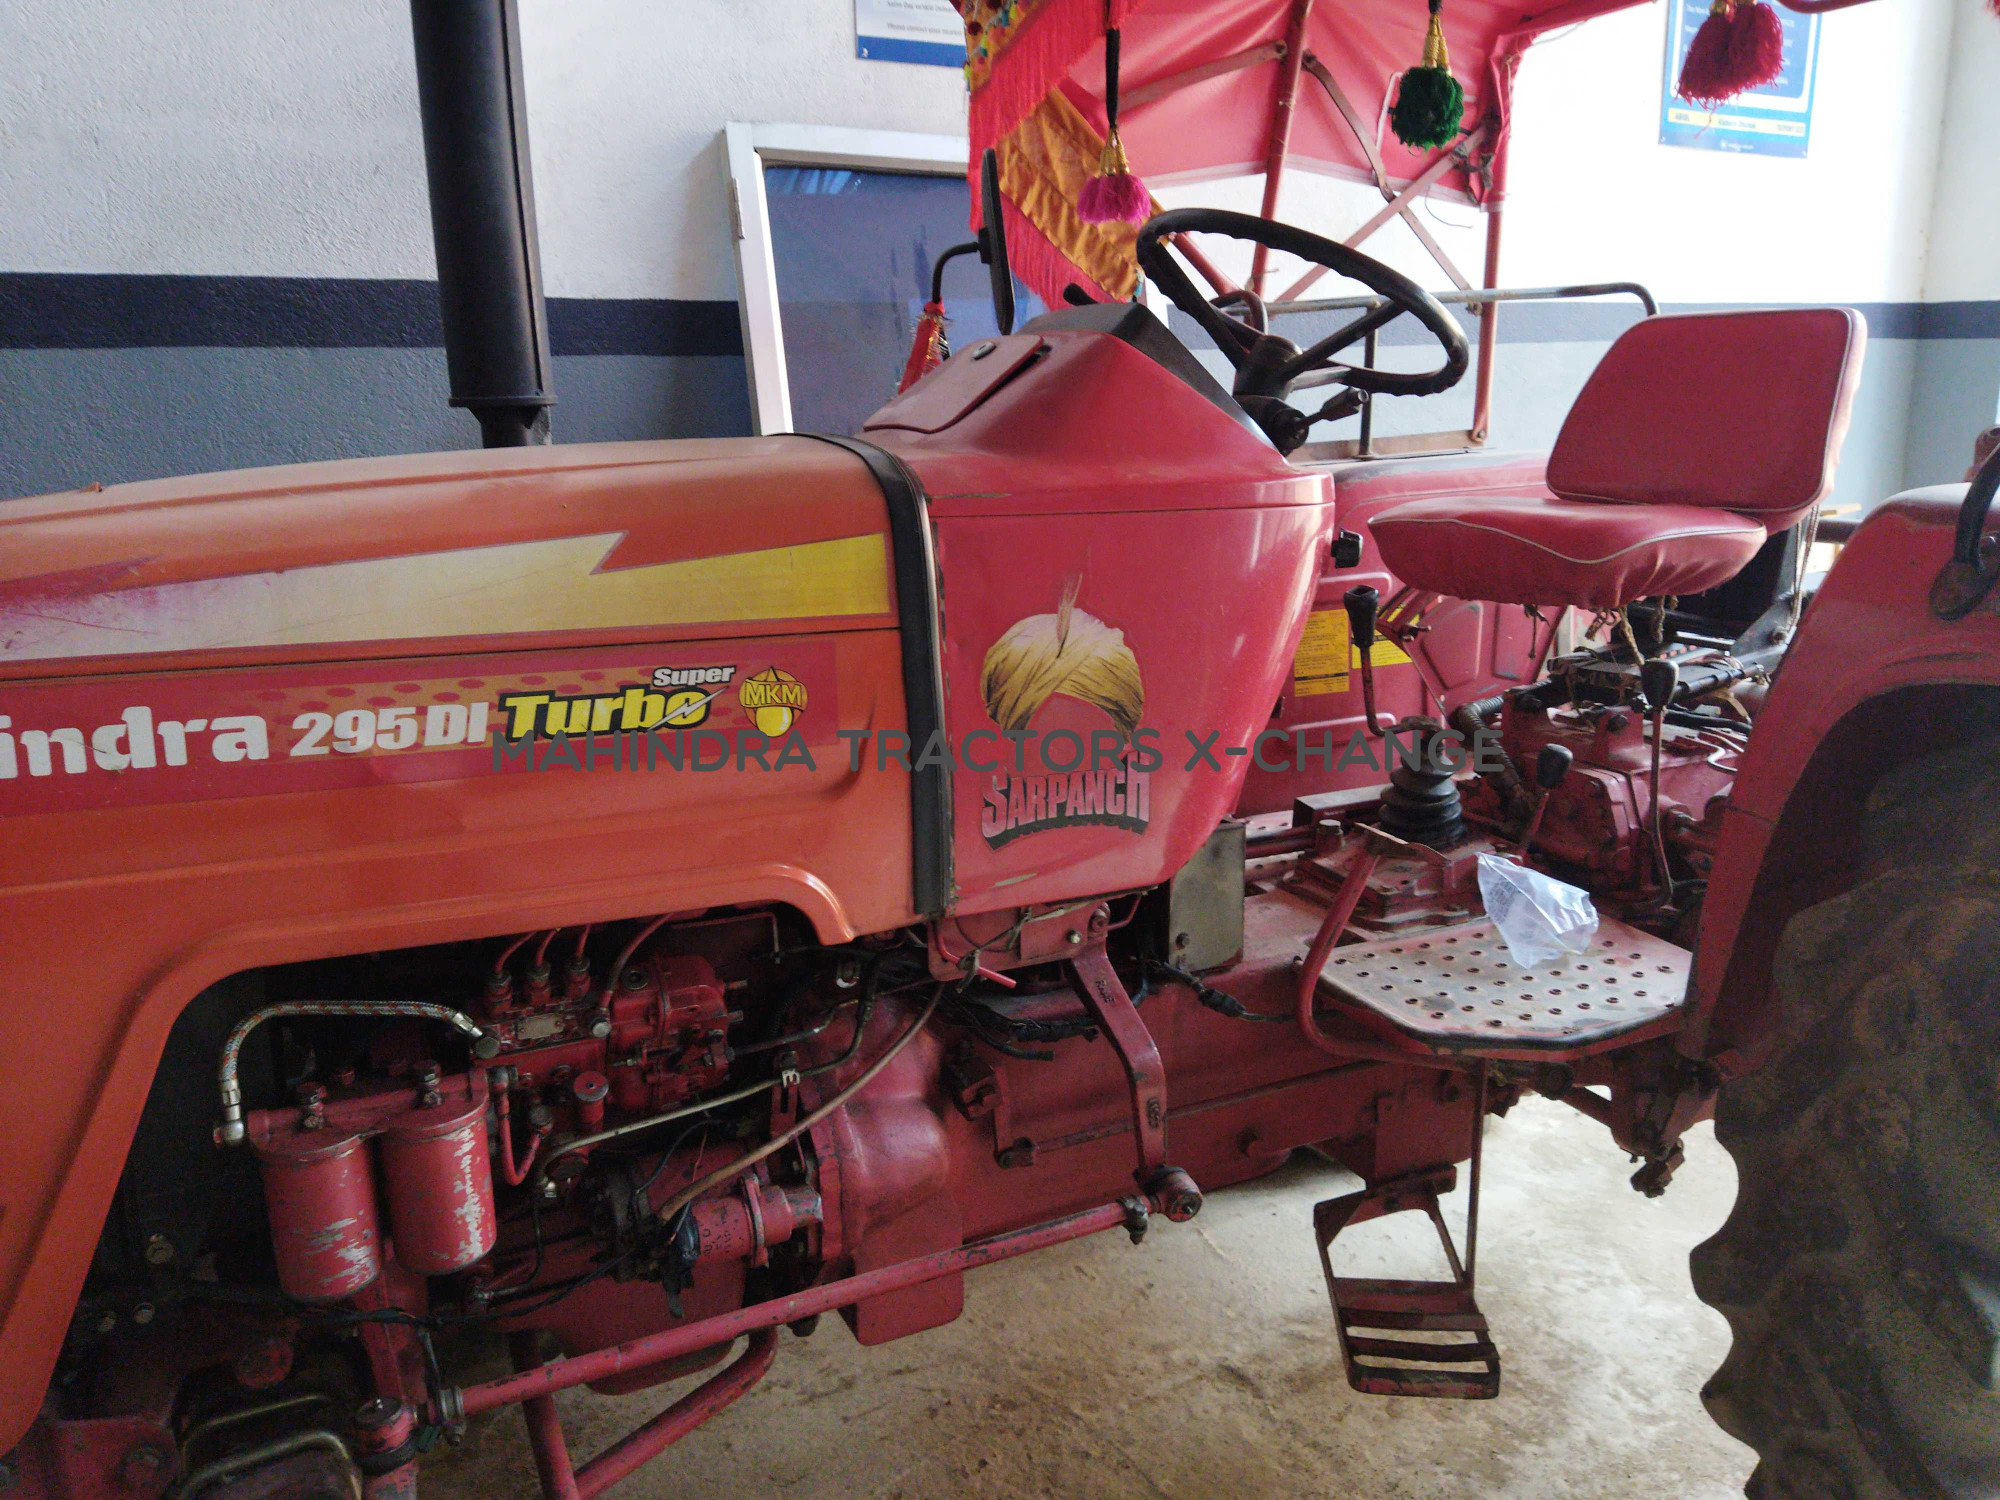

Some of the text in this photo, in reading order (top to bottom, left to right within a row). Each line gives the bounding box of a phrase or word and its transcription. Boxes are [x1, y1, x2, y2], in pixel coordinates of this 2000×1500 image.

[652, 665, 735, 688] Super
[744, 682, 804, 708] MKM
[502, 685, 714, 742] Turbo
